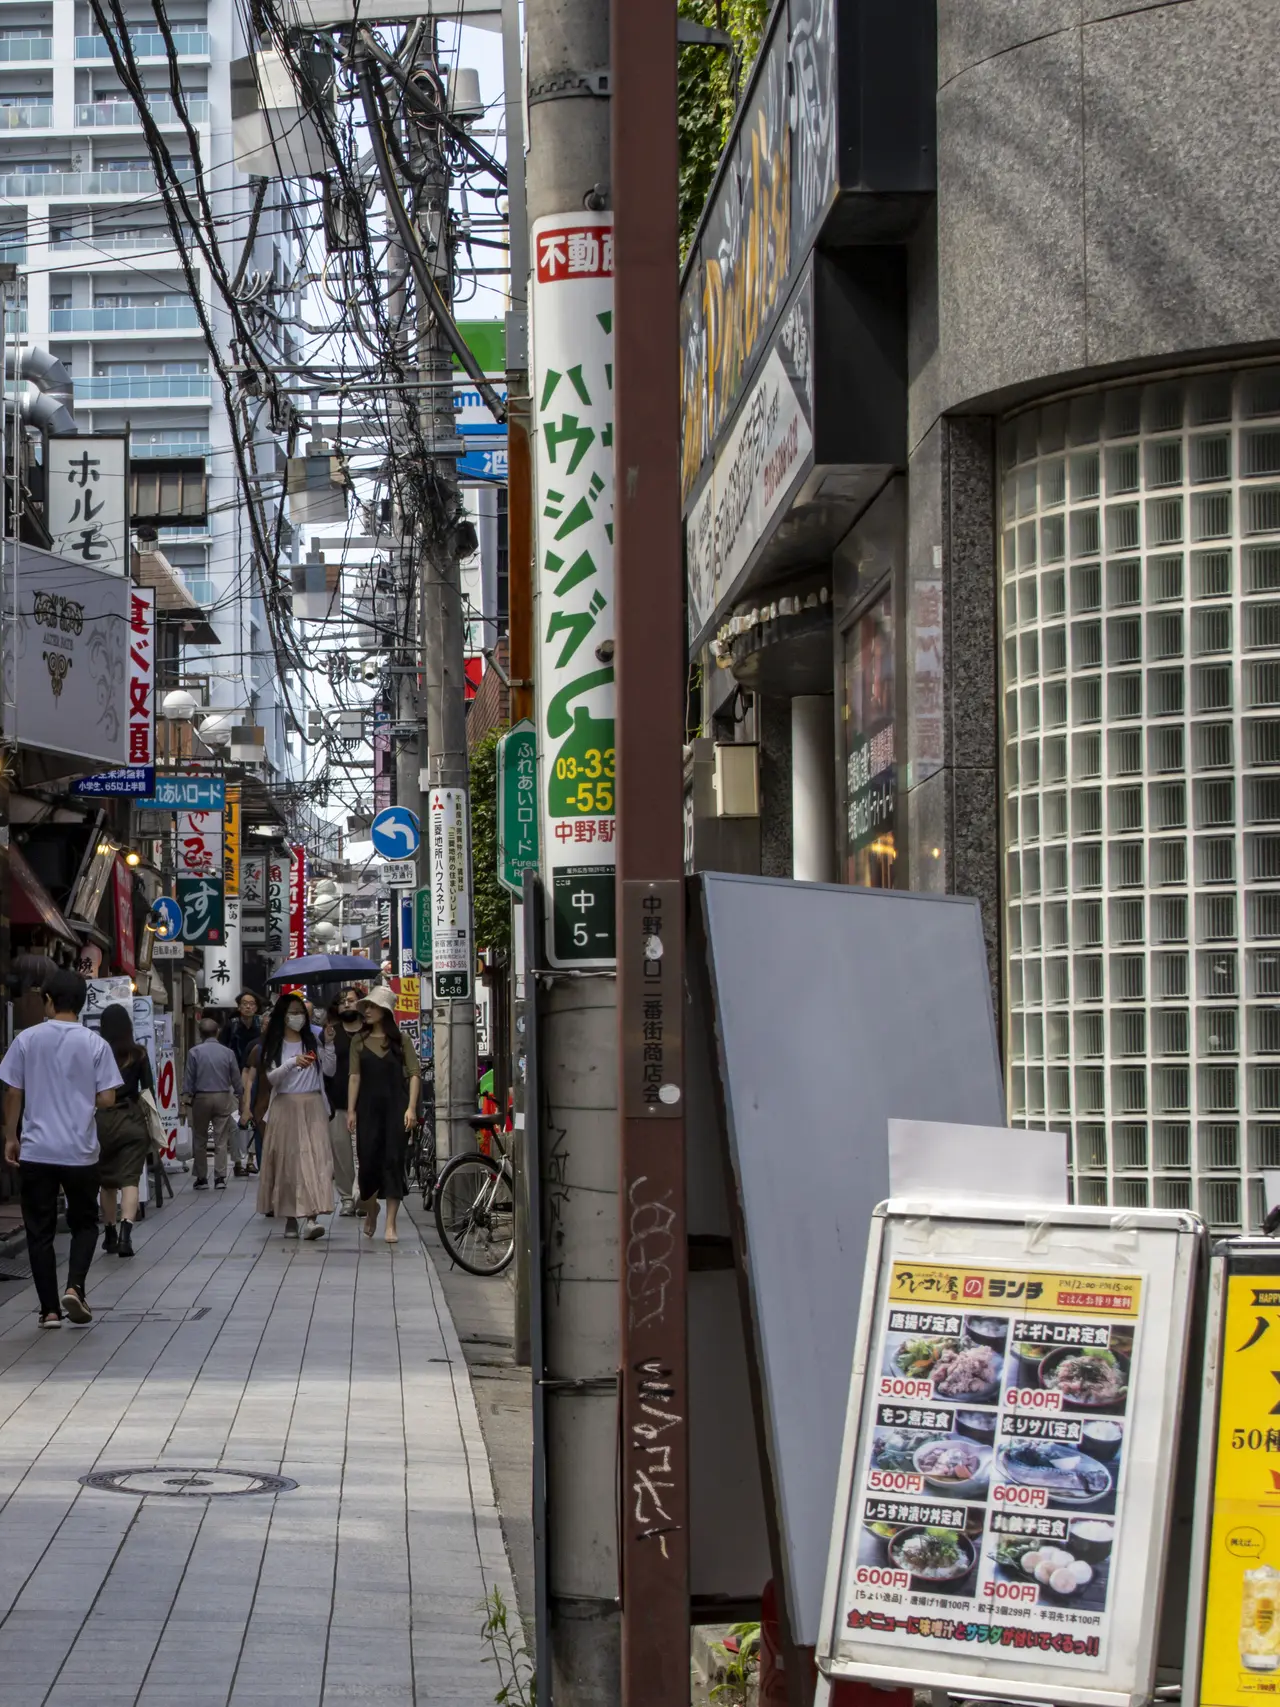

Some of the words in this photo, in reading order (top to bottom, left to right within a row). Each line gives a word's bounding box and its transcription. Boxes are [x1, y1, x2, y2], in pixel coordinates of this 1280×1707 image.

[68, 450, 108, 560] ホルモ
[540, 364, 608, 669] ハウジング
[140, 783, 221, 805] れあいロード
[517, 742, 533, 853] ふれあいロード
[434, 813, 445, 926] 三菱地所ハウスネット
[448, 827, 457, 925] 「三菱地所の住まいリレー
[181, 880, 219, 941] すし
[572, 889, 594, 913] 中
[440, 987, 462, 995] 5-36
[642, 895, 663, 1104] 中野口二番街商店会
[890, 1313, 960, 1333] 唐揚げ定食
[1015, 1323, 1109, 1345] ネギトロ丼定食
[880, 1379, 932, 1399] 500円
[1007, 1390, 1060, 1410] 600円
[882, 1408, 950, 1428] もつ煮定食
[1002, 1416, 1081, 1438] 炙りサバ定食
[871, 1472, 921, 1491] 500円
[993, 1486, 1045, 1506] 600円
[866, 1502, 964, 1526] しらす沖漬け丼定食
[857, 1568, 909, 1588] 600円
[983, 1582, 1036, 1602] 500円
